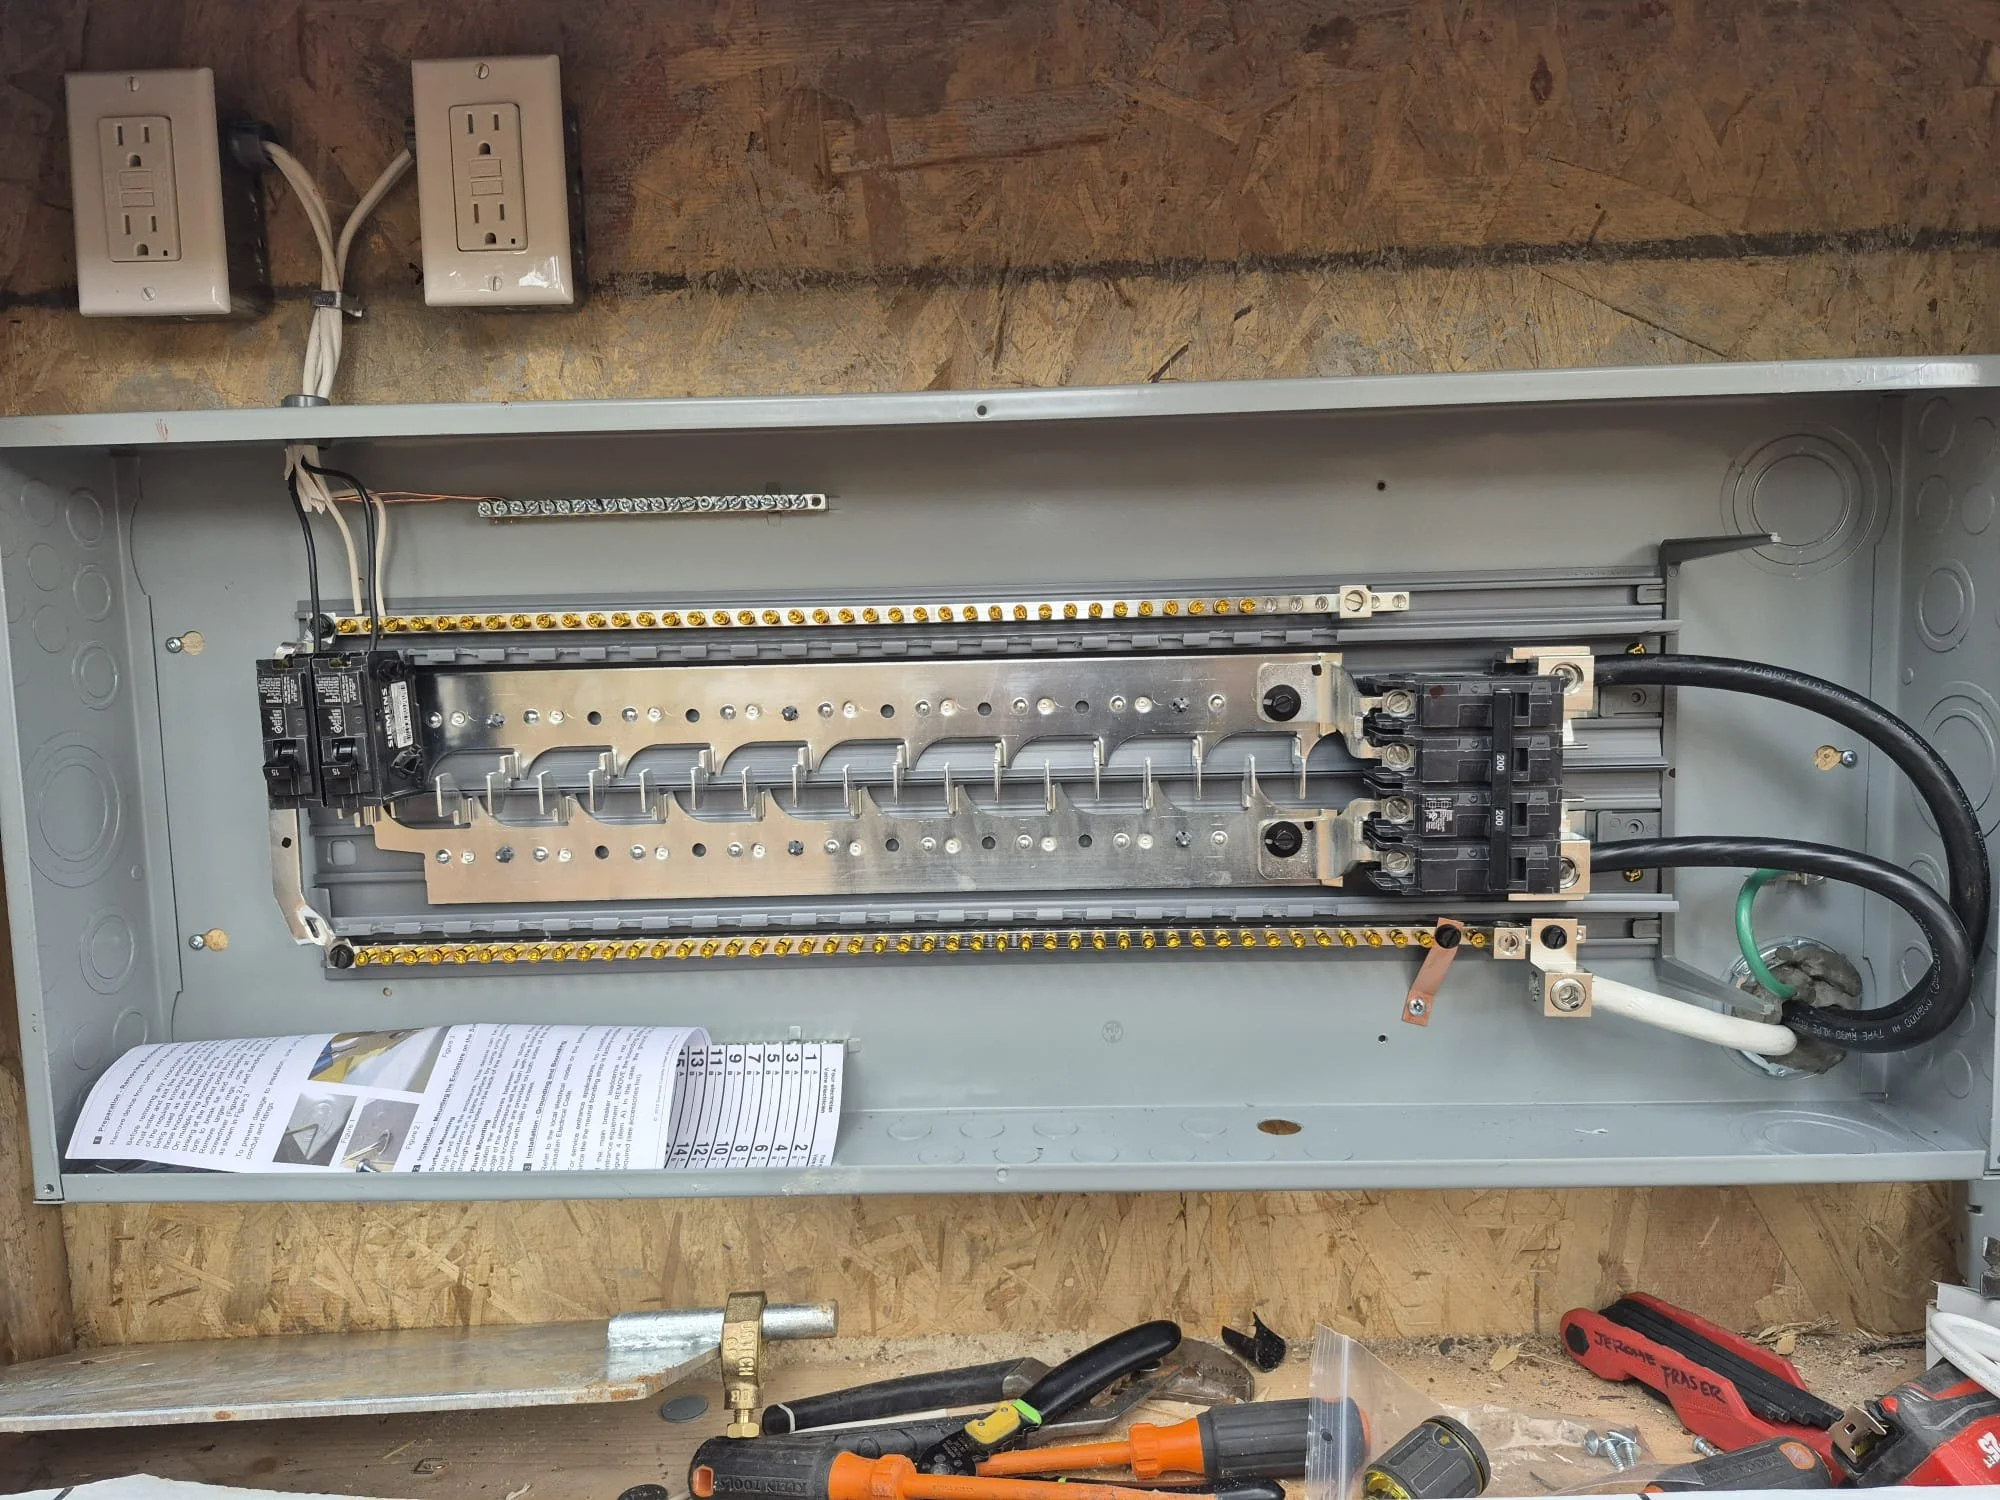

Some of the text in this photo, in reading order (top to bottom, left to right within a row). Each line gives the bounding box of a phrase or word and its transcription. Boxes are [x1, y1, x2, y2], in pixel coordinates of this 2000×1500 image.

[382, 688, 394, 750] SIEMENS
[1496, 754, 1505, 771] 200
[332, 768, 340, 776] 15
[1495, 810, 1504, 826] 200
[691, 1050, 703, 1067] 13
[710, 1048, 722, 1064] 11
[729, 1053, 741, 1063] 9
[748, 1053, 760, 1063] 7
[767, 1053, 779, 1062] 5
[786, 1053, 798, 1062] 3
[674, 1142, 689, 1155] 14
[694, 1142, 709, 1155] 12
[714, 1141, 729, 1154] 10
[1594, 1331, 1656, 1366] JEROME
[1660, 1366, 1726, 1404] FRASER
